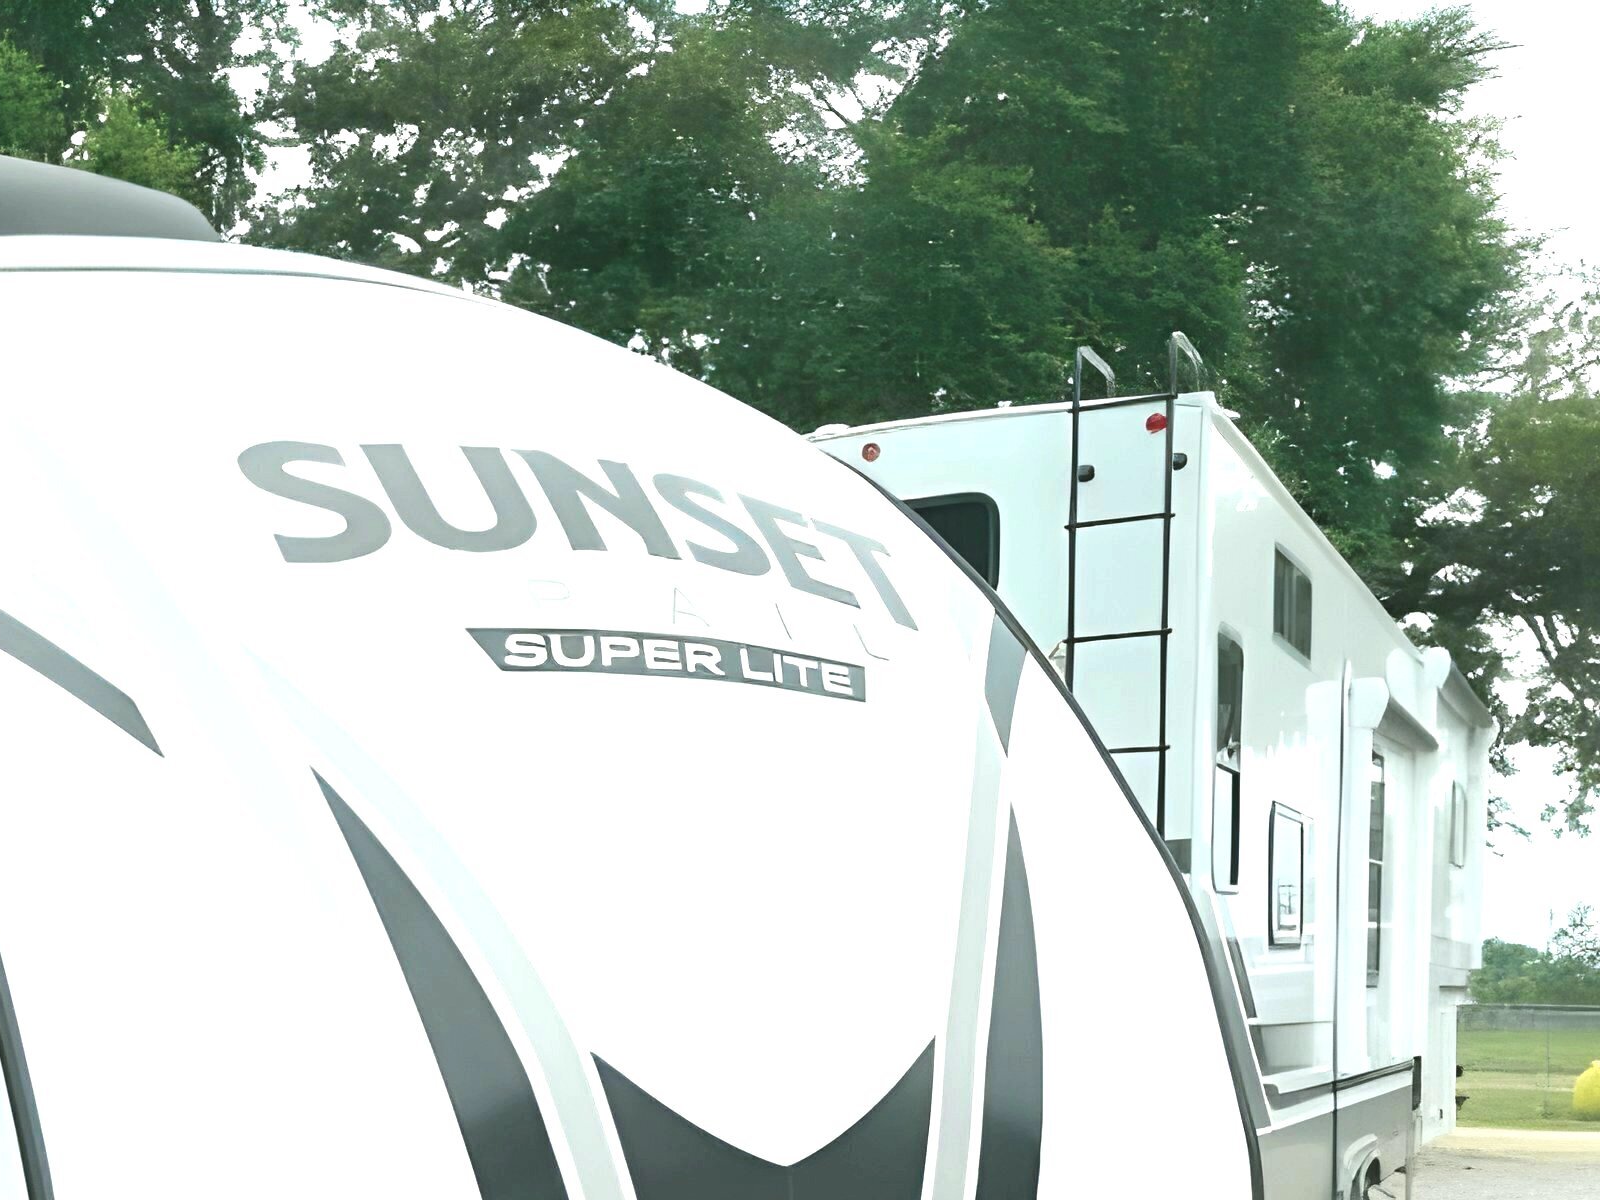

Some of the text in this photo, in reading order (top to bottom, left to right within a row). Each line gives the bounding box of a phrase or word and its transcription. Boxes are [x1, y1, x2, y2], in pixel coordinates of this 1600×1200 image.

[237, 440, 918, 631] SUNSET
[503, 633, 854, 696] SUPER LITE
